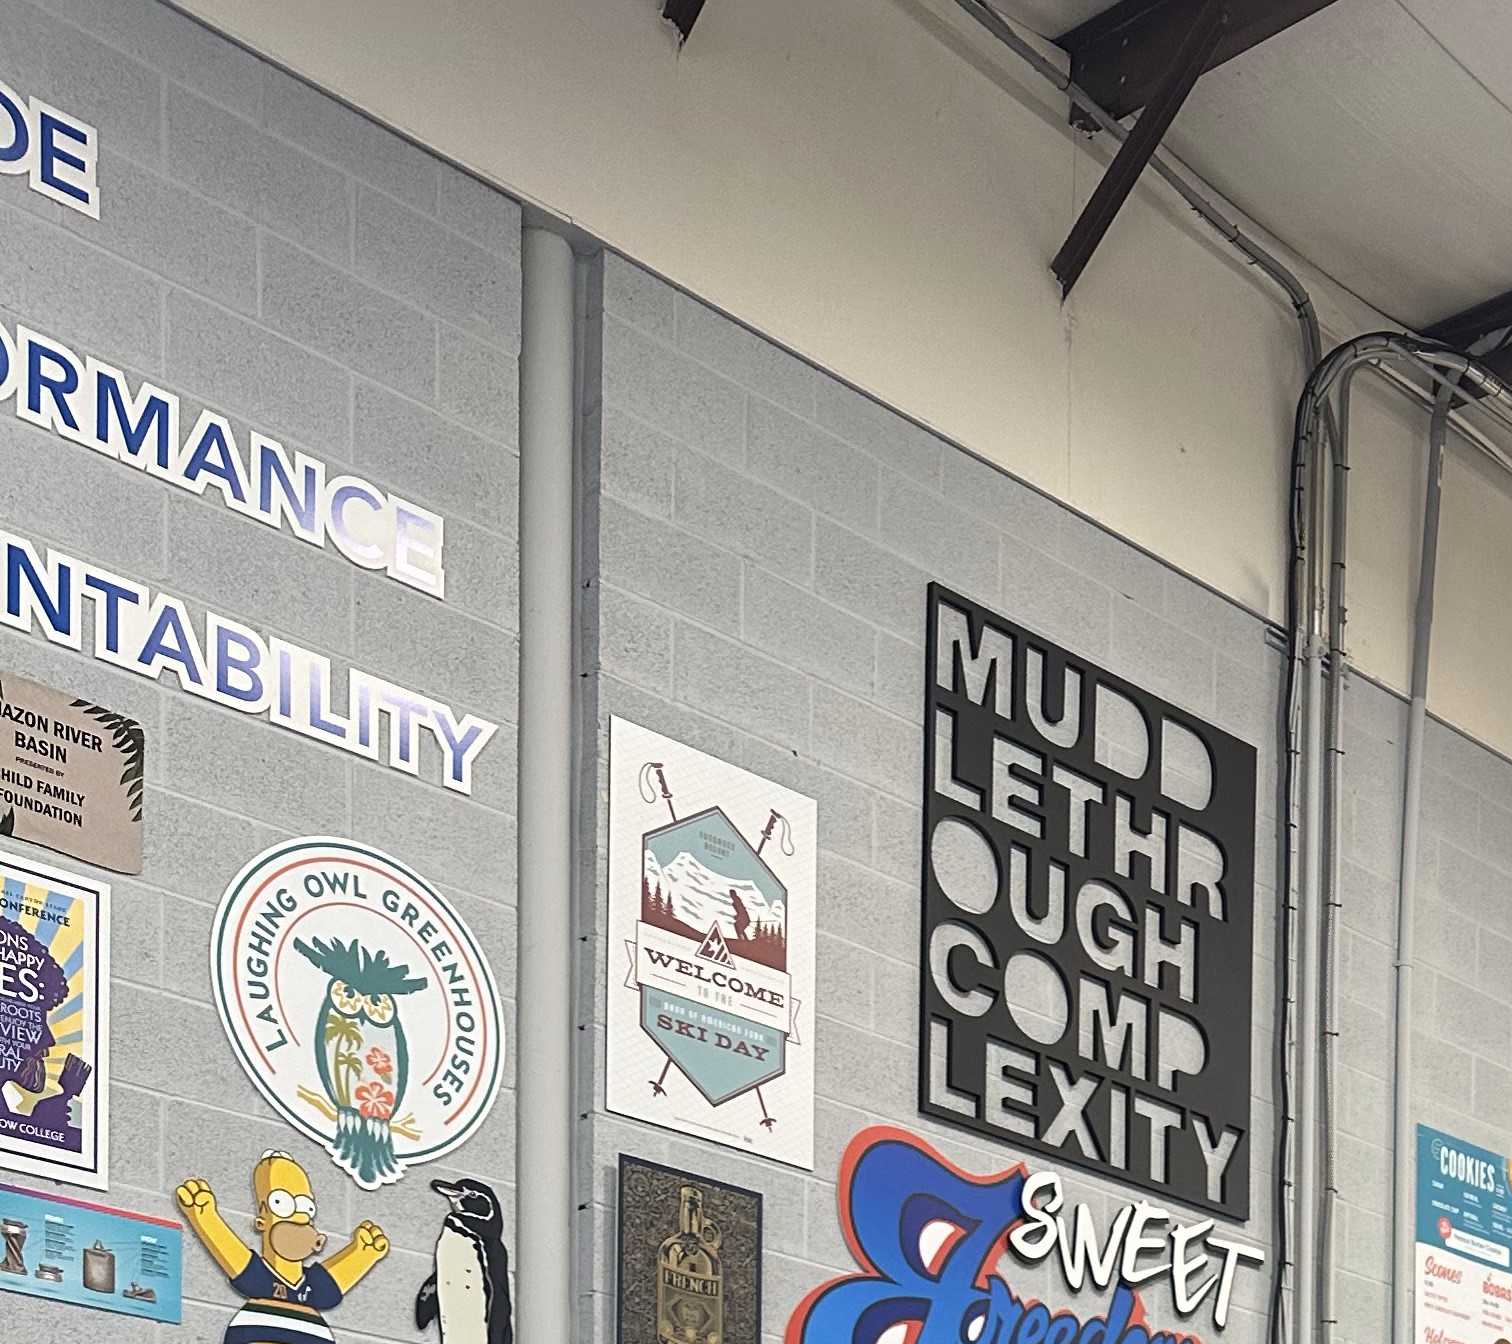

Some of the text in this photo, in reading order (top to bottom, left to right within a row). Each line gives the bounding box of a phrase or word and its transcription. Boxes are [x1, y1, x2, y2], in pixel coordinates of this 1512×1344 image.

[0, 334, 442, 592] RMANCE
[0, 703, 103, 753] AZON RIVER
[14, 730, 67, 764] BASIN
[935, 602, 1217, 811] MUDD
[36, 779, 86, 808] FAMILY
[933, 705, 1228, 922] LETHR
[246, 871, 478, 1107] LAUGHING OWL GREENHOUSES
[643, 946, 785, 1009] WELCOME
[929, 815, 1199, 1003] OUGH
[656, 1013, 770, 1062] SKI DAY
[928, 920, 1207, 1092] COMP
[19, 1123, 66, 1143] COLLEGE
[928, 1013, 1244, 1204] LEXITY
[1439, 1145, 1496, 1193] COOKIES
[1009, 1171, 1265, 1331] SWEET
